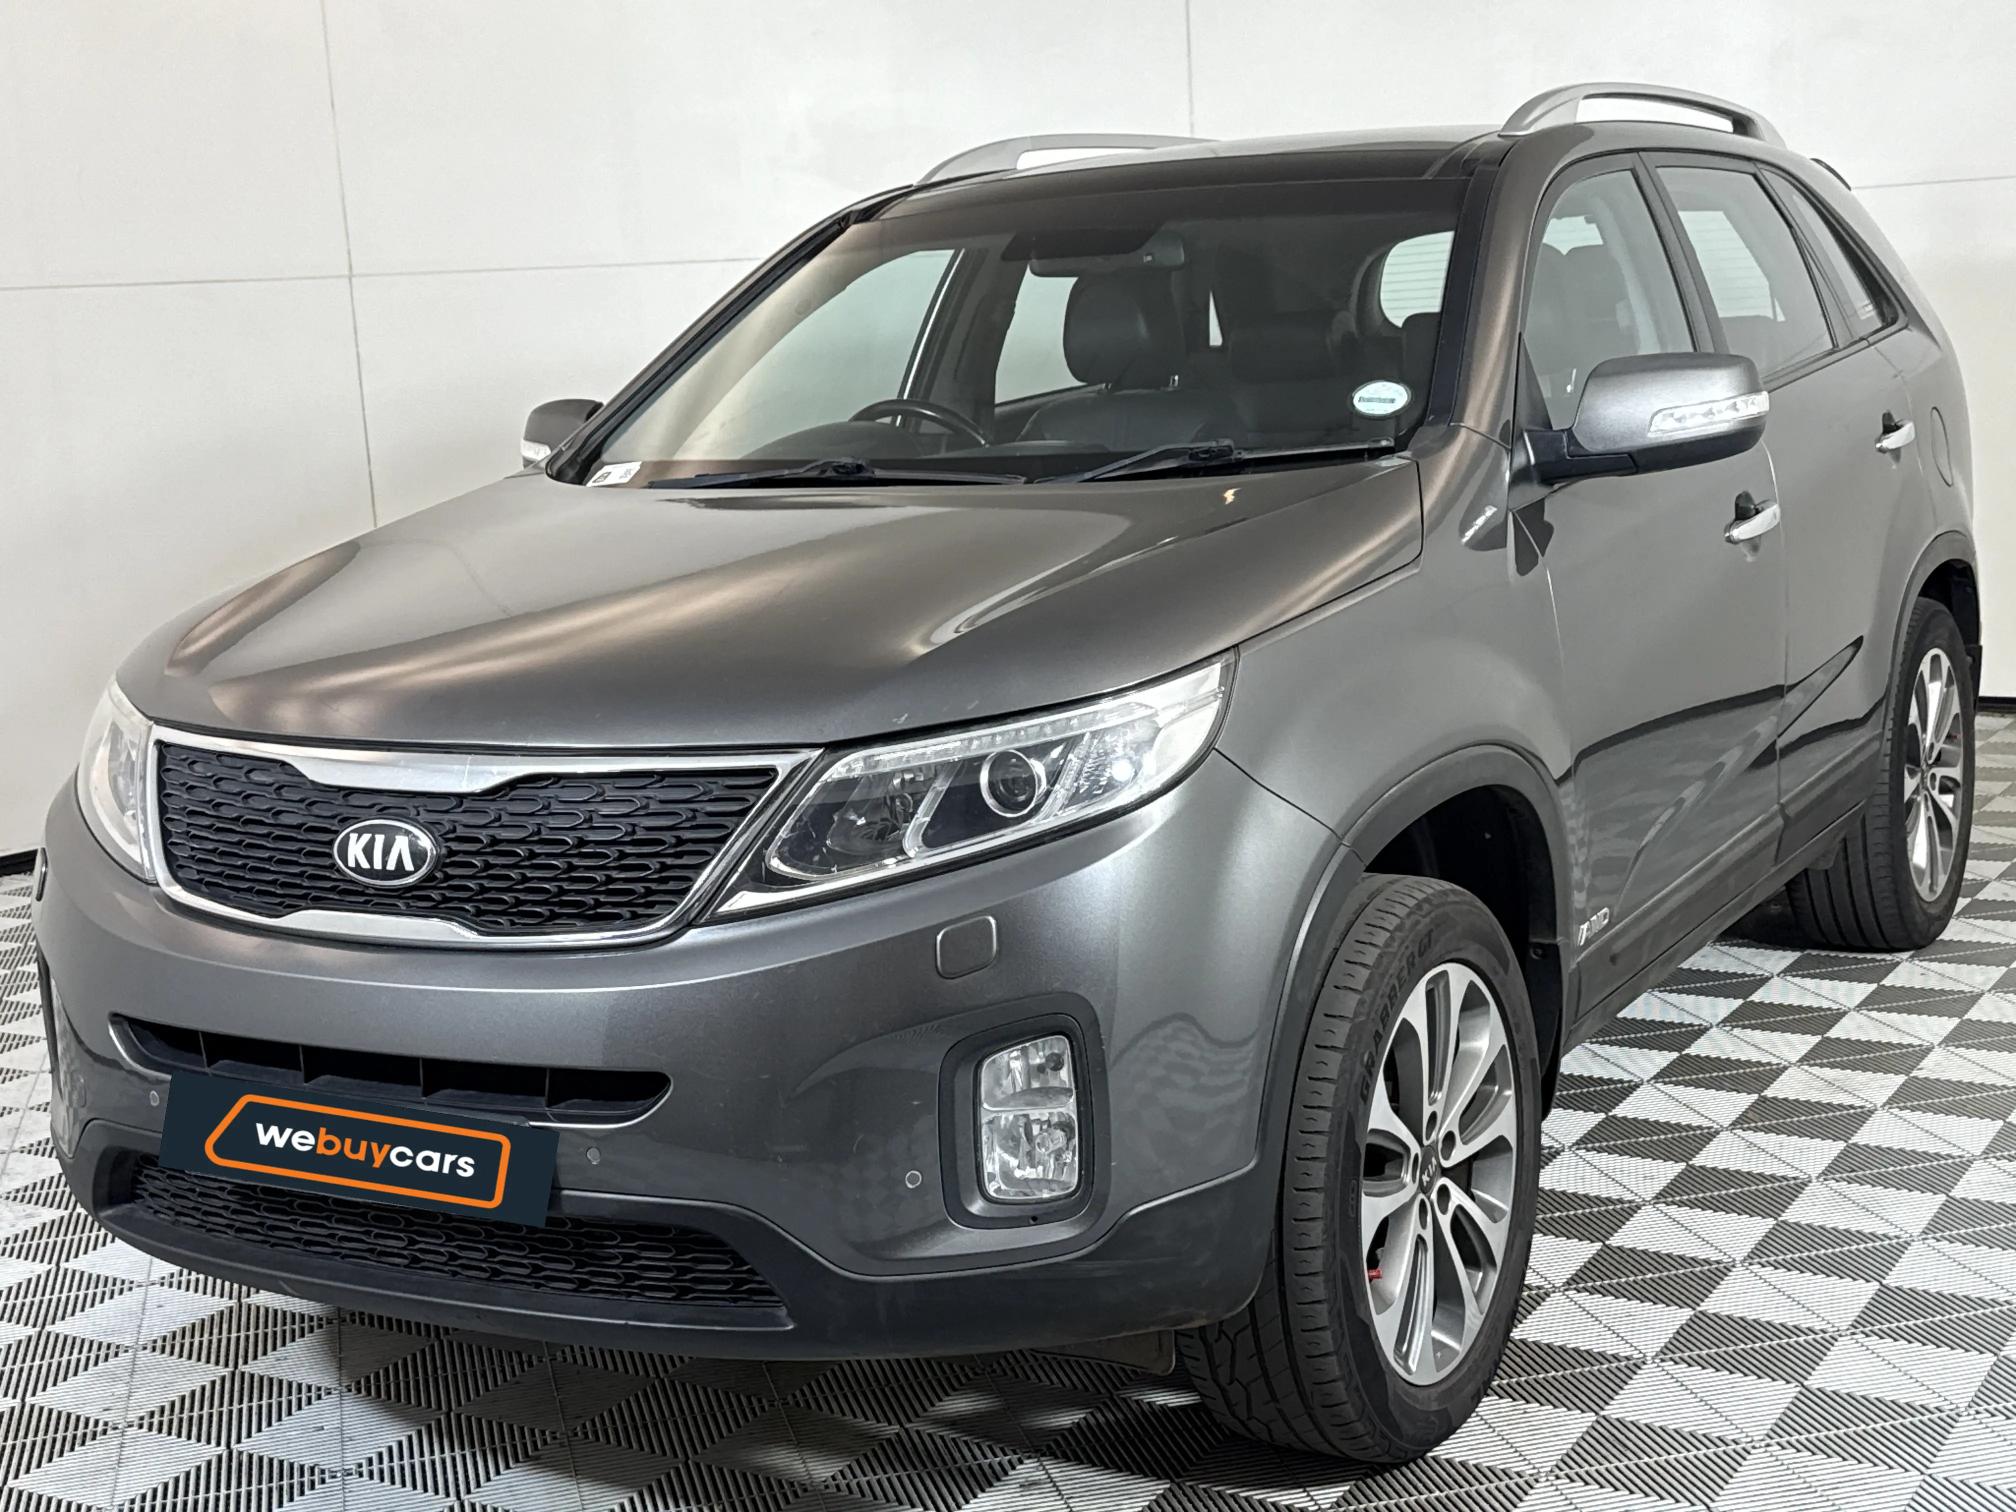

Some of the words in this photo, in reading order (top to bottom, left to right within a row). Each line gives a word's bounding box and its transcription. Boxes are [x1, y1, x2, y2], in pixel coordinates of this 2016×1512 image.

[347, 832, 415, 871] KIA
[1360, 950, 1416, 1105] GRABBER
[1421, 1155, 1438, 1187] KIA
